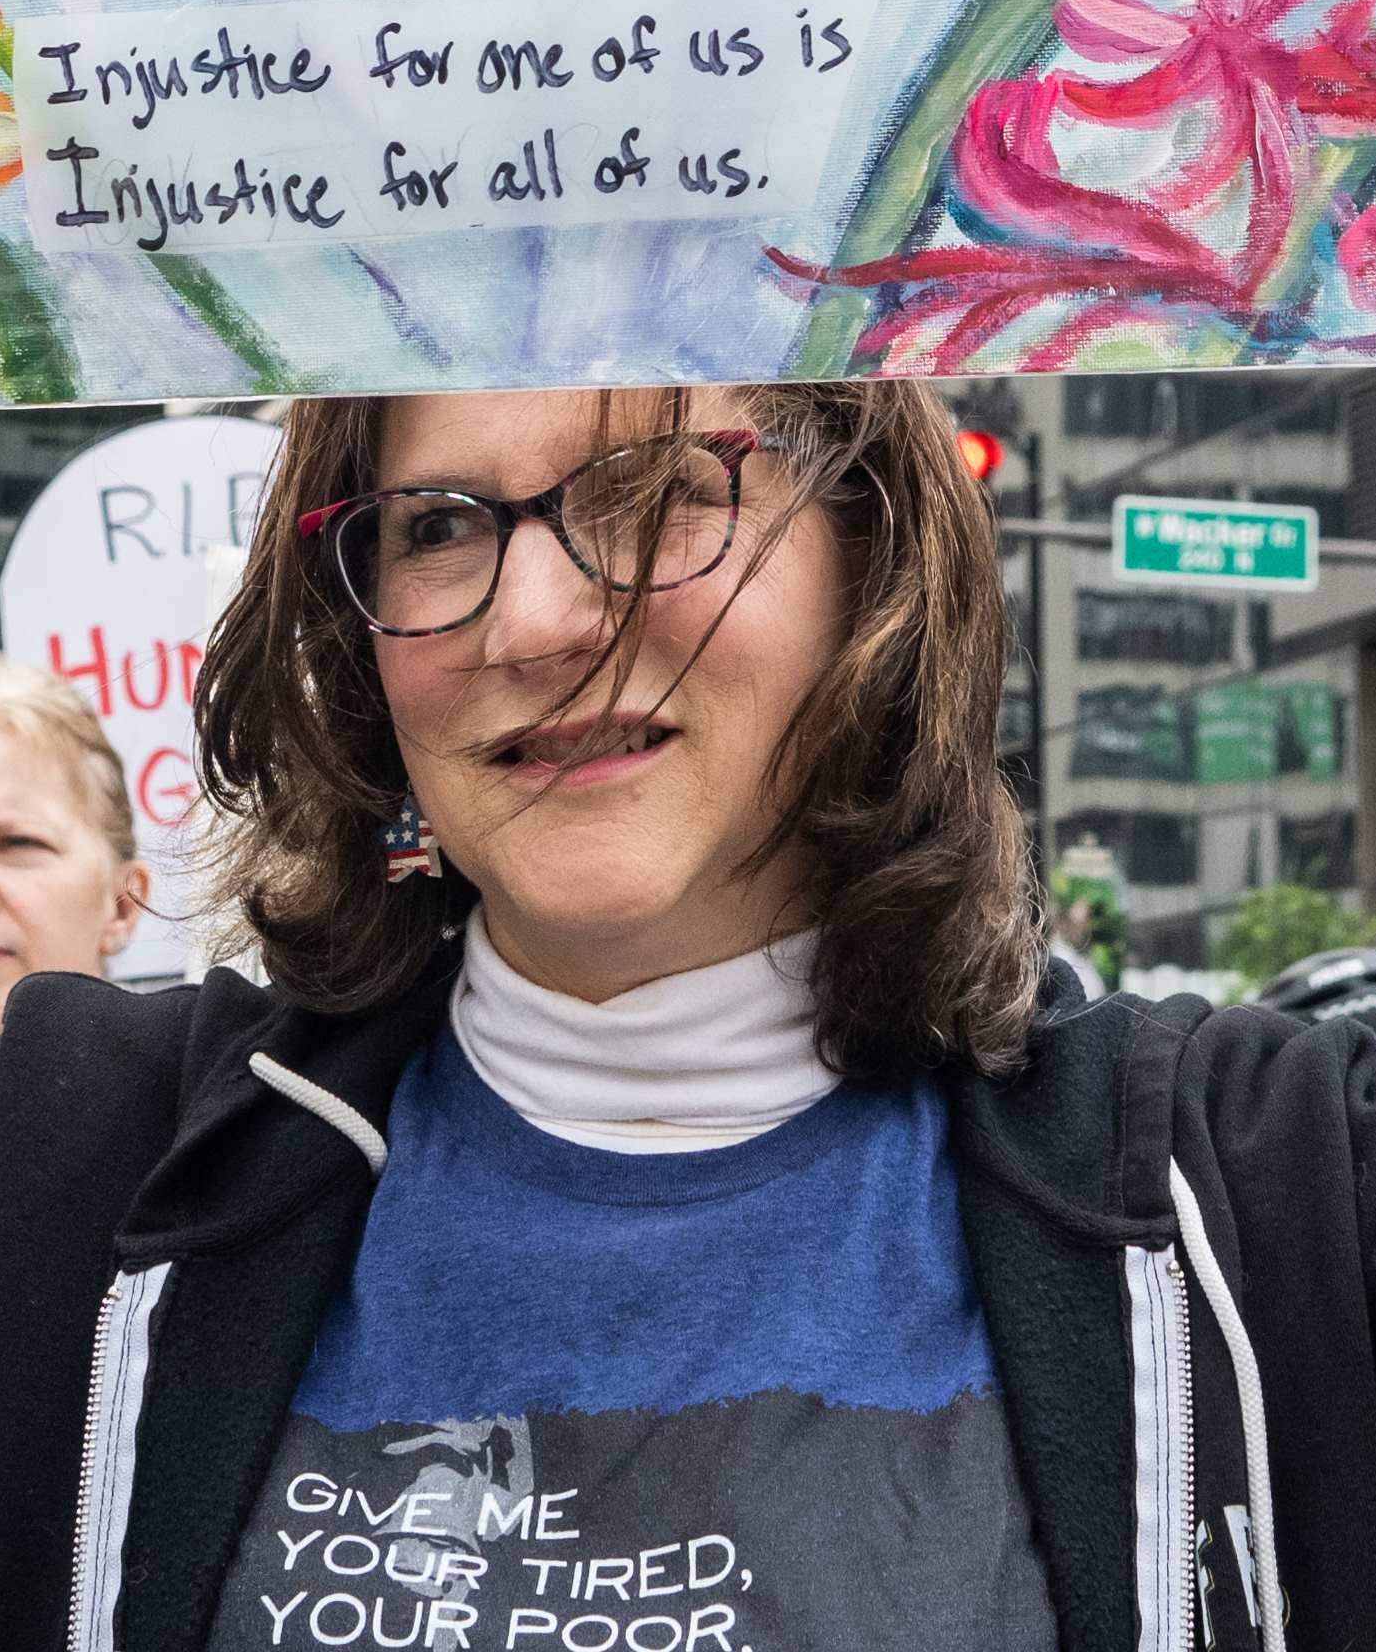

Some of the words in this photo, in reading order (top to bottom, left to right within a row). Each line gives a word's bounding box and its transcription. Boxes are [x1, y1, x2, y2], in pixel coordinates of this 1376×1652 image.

[38, 27, 333, 130] Injustice
[369, 21, 456, 89] for
[477, 38, 573, 94] one
[591, 15, 656, 80] of
[689, 22, 764, 74] us
[797, 7, 854, 72] is
[46, 135, 346, 252] Injustice
[379, 141, 459, 212] for
[488, 139, 560, 201] all
[593, 126, 652, 194] of
[677, 146, 770, 197] us.
[285, 1472, 451, 1536] GIVE
[477, 1488, 579, 1540] ME
[277, 1529, 489, 1590] YOUR
[522, 1534, 753, 1601] TIRED,
[260, 1591, 479, 1649] YOUR
